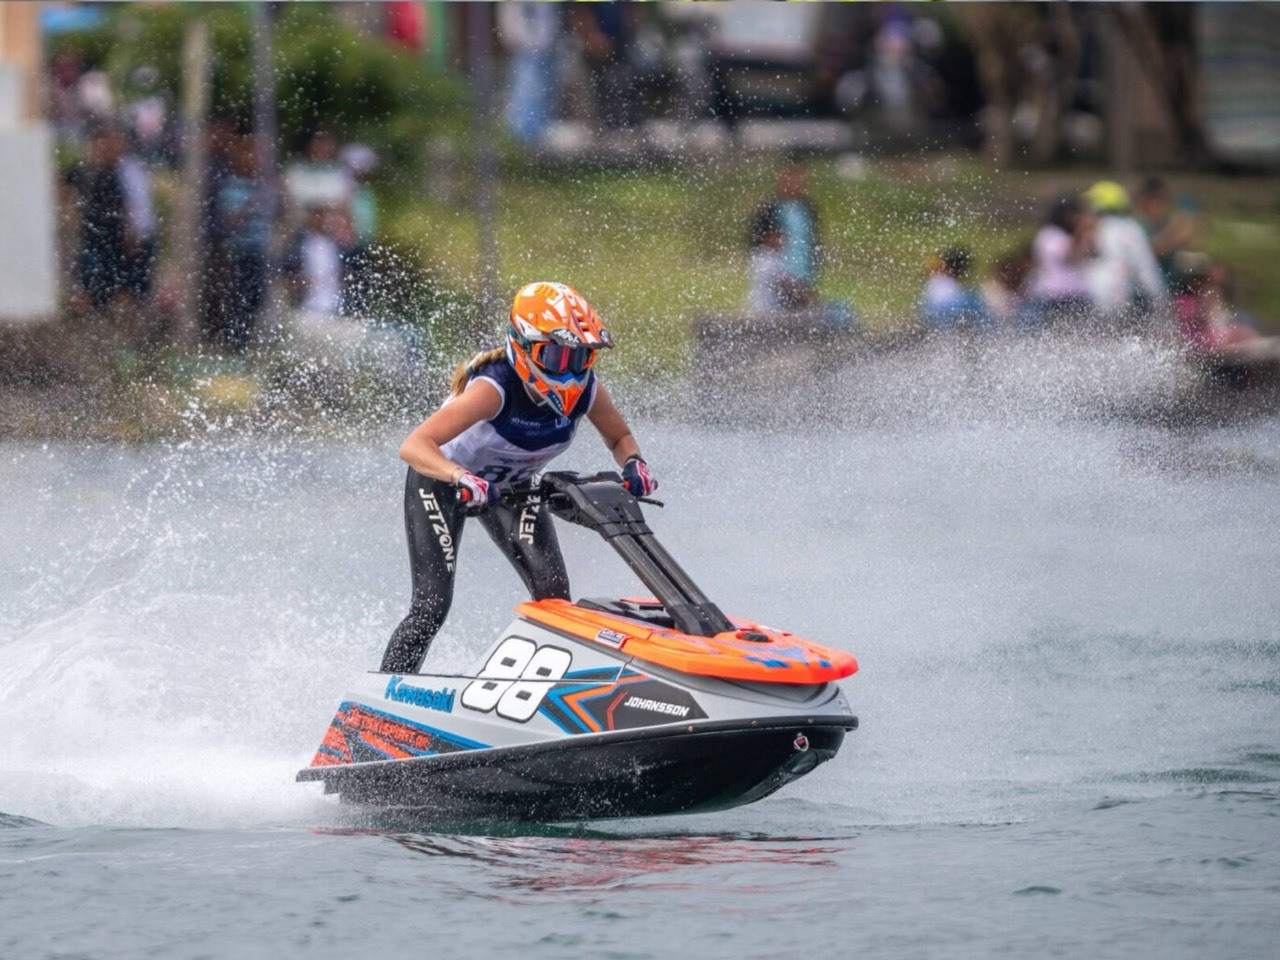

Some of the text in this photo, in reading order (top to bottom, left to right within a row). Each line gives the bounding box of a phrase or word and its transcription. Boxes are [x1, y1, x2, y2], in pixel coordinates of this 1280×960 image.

[418, 488, 456, 572] JETZONE
[384, 675, 457, 713] Kawasaki
[461, 635, 573, 723] 88
[624, 696, 690, 717] JOHANSSON
